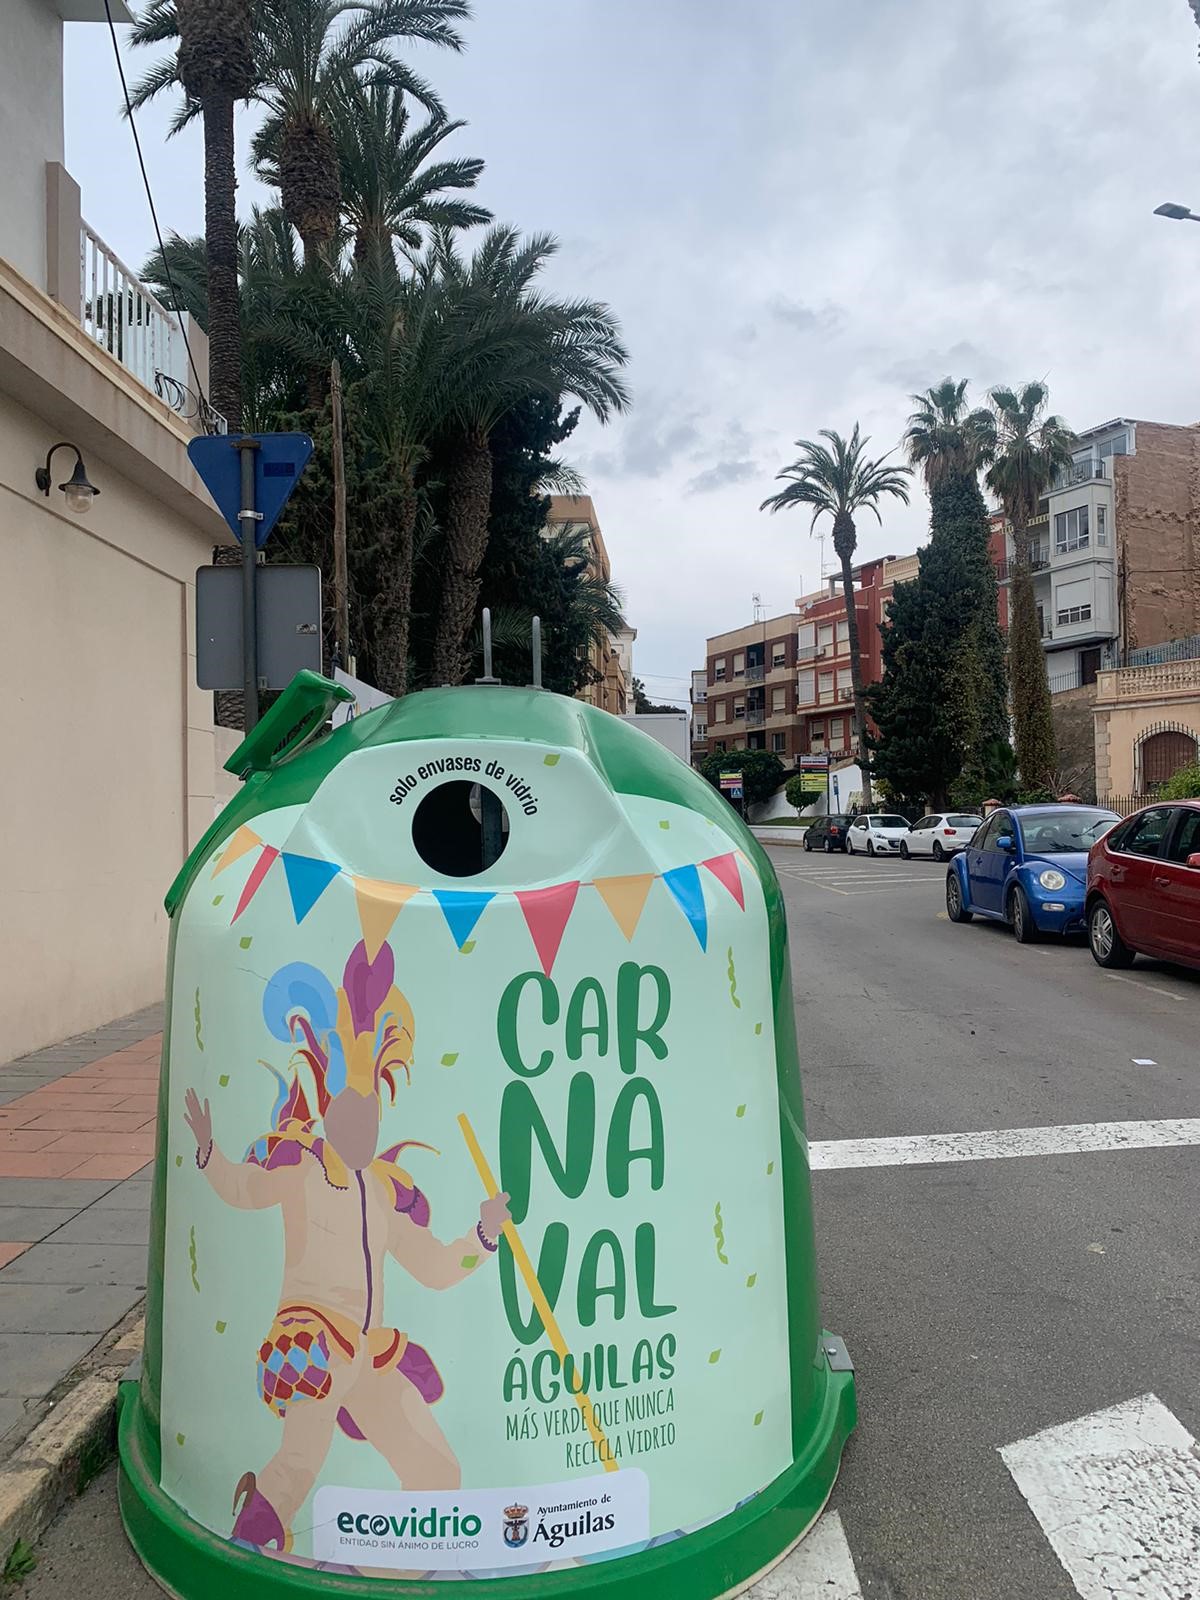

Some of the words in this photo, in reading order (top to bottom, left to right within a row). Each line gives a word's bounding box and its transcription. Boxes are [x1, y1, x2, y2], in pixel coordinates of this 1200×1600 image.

[389, 774, 417, 805] solo
[417, 757, 482, 779] envases
[485, 760, 504, 780] de
[505, 774, 538, 816] vidrio
[503, 1333, 676, 1403] ÁGUILAS
[506, 1407, 538, 1440] MÁS
[544, 1405, 588, 1436] VERDE
[592, 1399, 620, 1432] QUE
[625, 1388, 674, 1422] NUNCA
[337, 1506, 482, 1538] ecovidrio
[536, 1498, 598, 1517] Ayuntamiento
[600, 1494, 612, 1504] de
[340, 1537, 378, 1548] ENTIDAD
[380, 1541, 396, 1549] SIN
[431, 1542, 444, 1550] DE
[446, 1540, 479, 1550] LUCRO
[532, 1511, 615, 1548] Águilas
